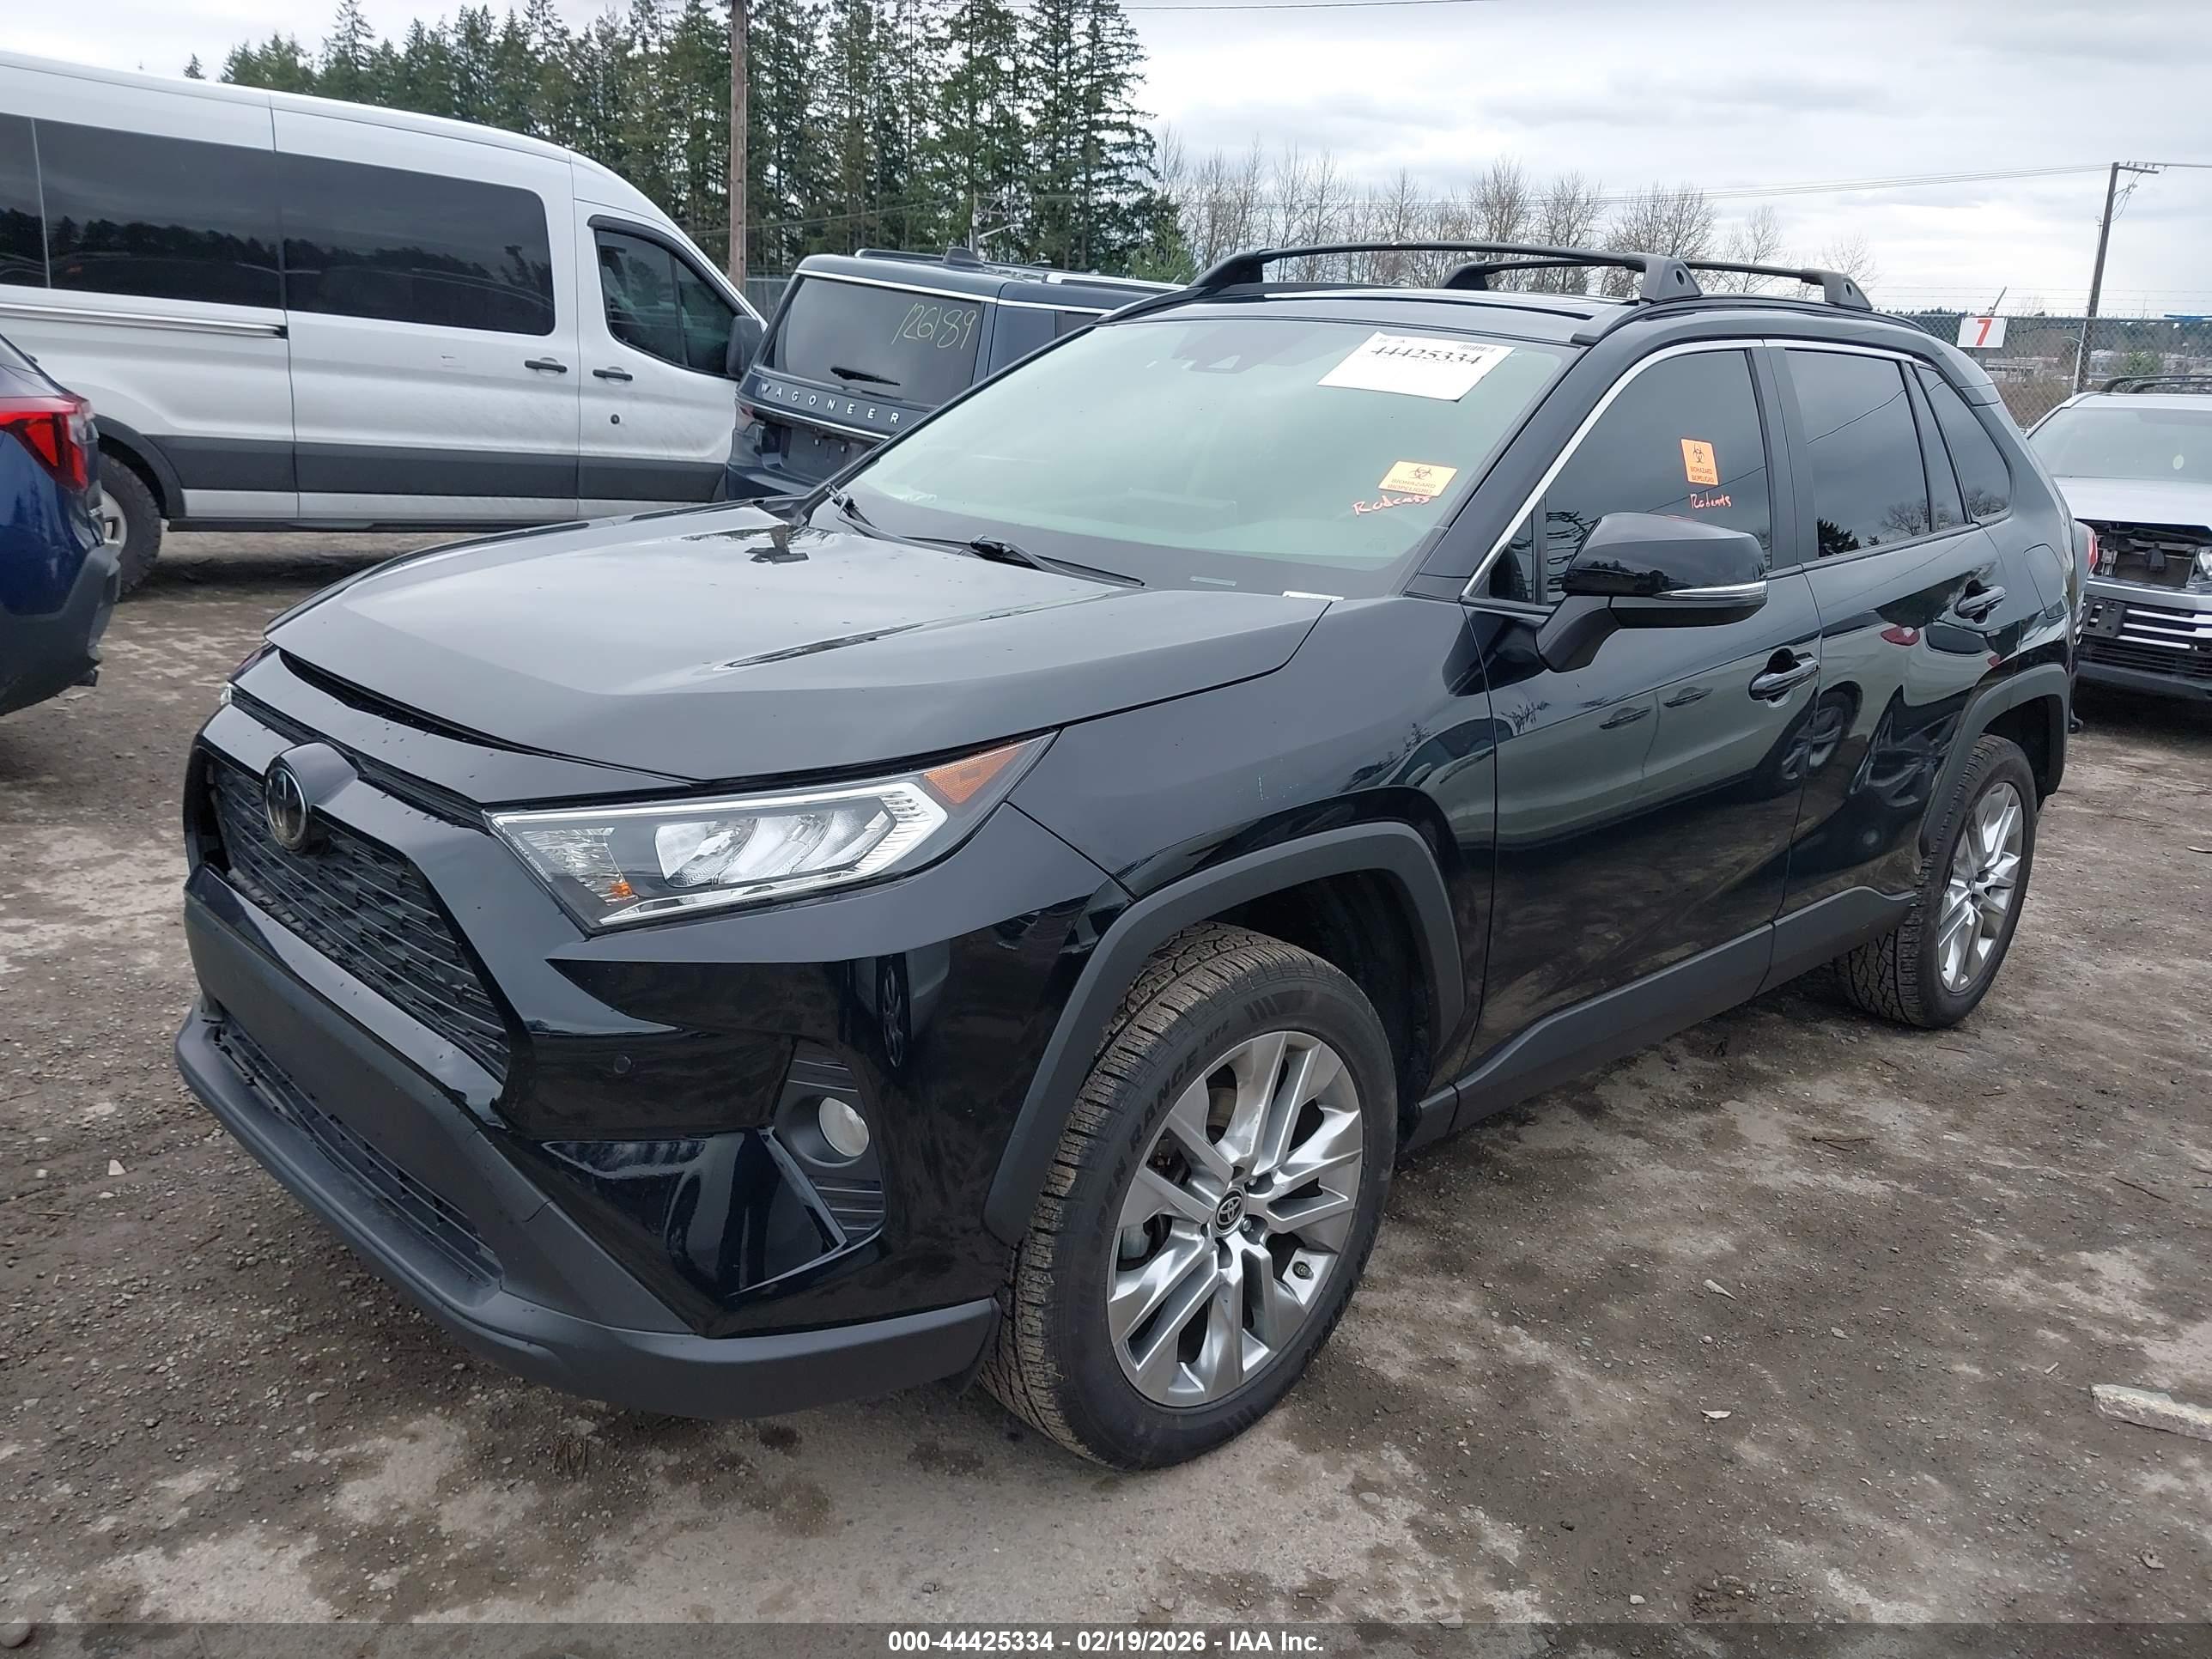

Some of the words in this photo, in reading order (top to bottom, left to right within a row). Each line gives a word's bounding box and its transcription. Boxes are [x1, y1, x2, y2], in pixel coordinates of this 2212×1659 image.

[890, 302, 977, 349] 126189
[1975, 319, 1993, 346] 7
[1370, 345, 1483, 365] 44425334
[761, 382, 900, 424] WAGONEER
[1128, 1046, 1200, 1153] RANGE
